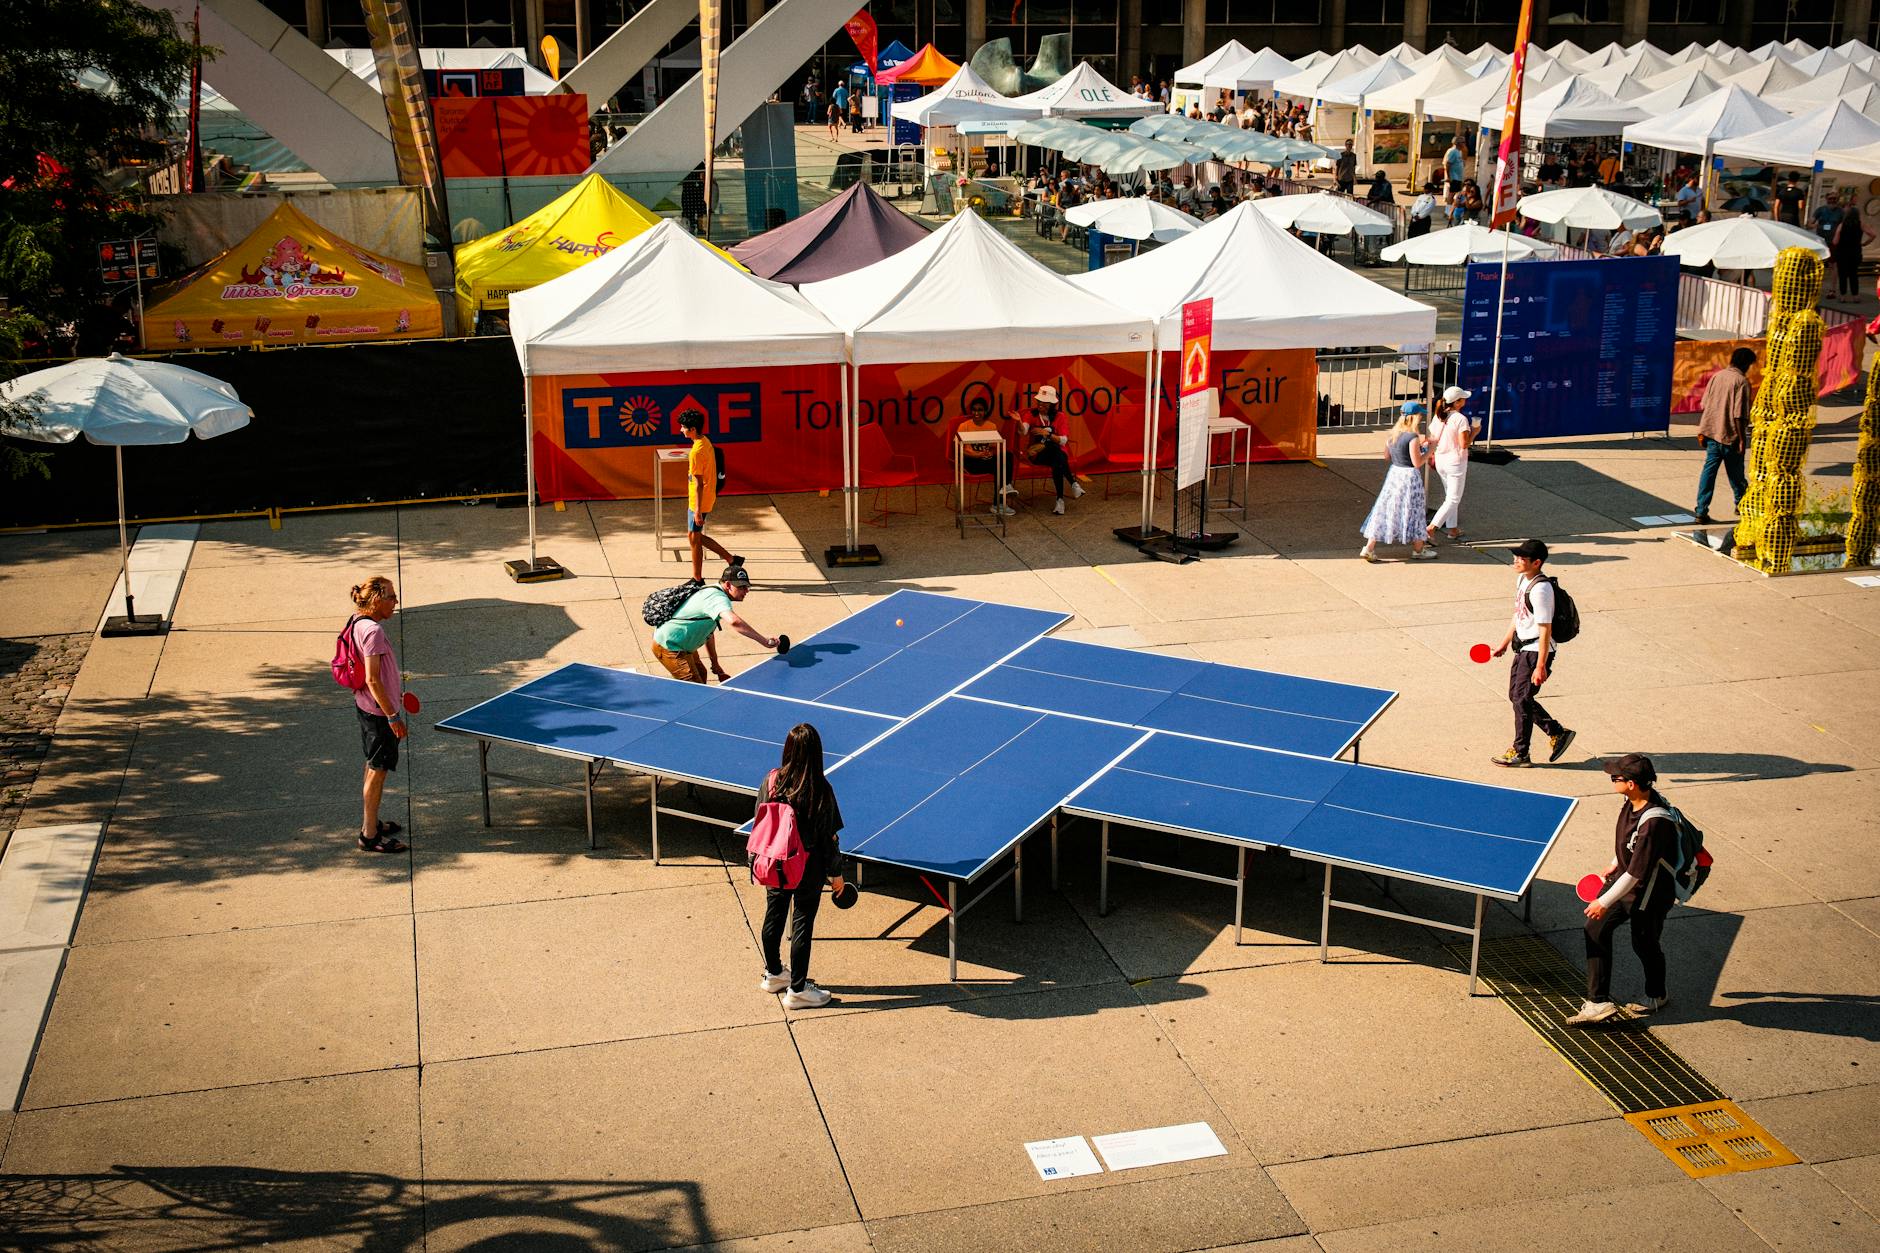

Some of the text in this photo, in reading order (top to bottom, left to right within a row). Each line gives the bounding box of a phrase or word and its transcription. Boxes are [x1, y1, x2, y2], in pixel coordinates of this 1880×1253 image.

[955, 89, 998, 99] Dillons
[285, 284, 359, 300] Greasy
[781, 389, 944, 431] Toronto
[1220, 367, 1288, 407] Fair
